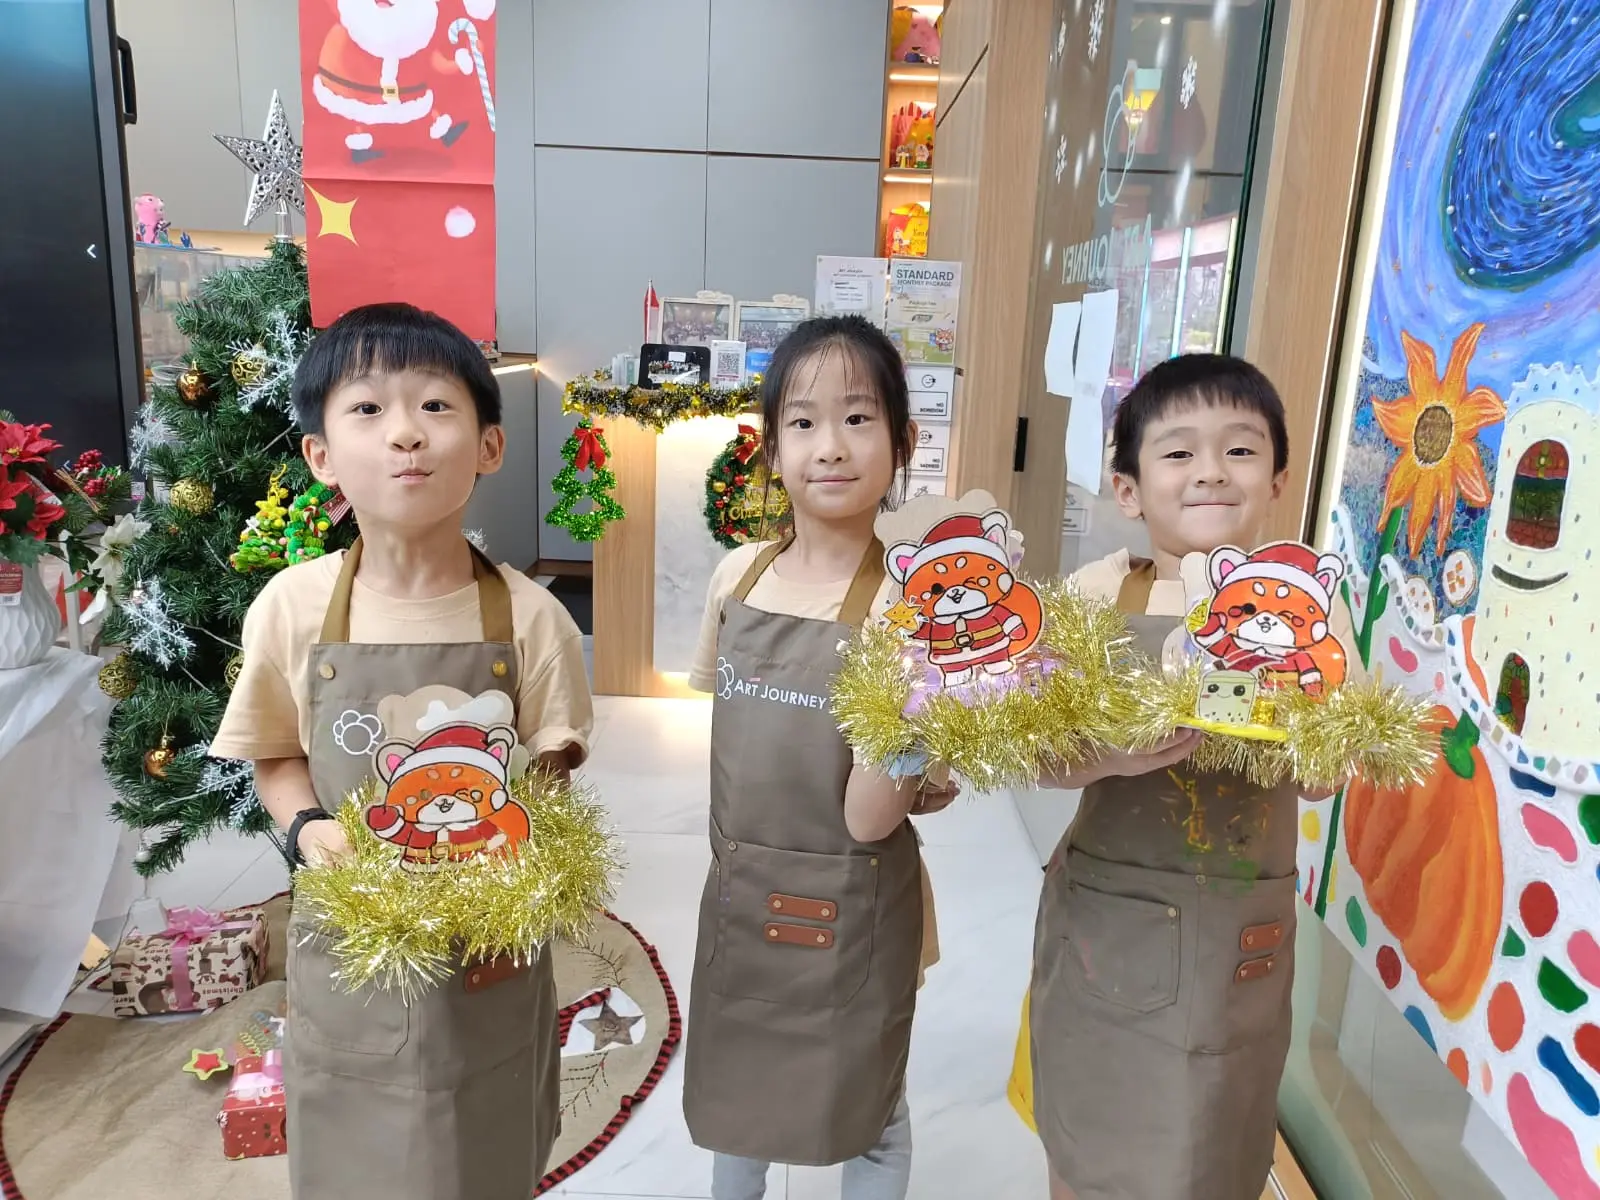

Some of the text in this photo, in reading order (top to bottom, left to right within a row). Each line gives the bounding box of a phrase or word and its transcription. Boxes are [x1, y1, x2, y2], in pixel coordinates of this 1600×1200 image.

[896, 268, 954, 281] STANDARD
[734, 678, 827, 710] ART JOURNEY
[202, 986, 244, 994] Christmas
